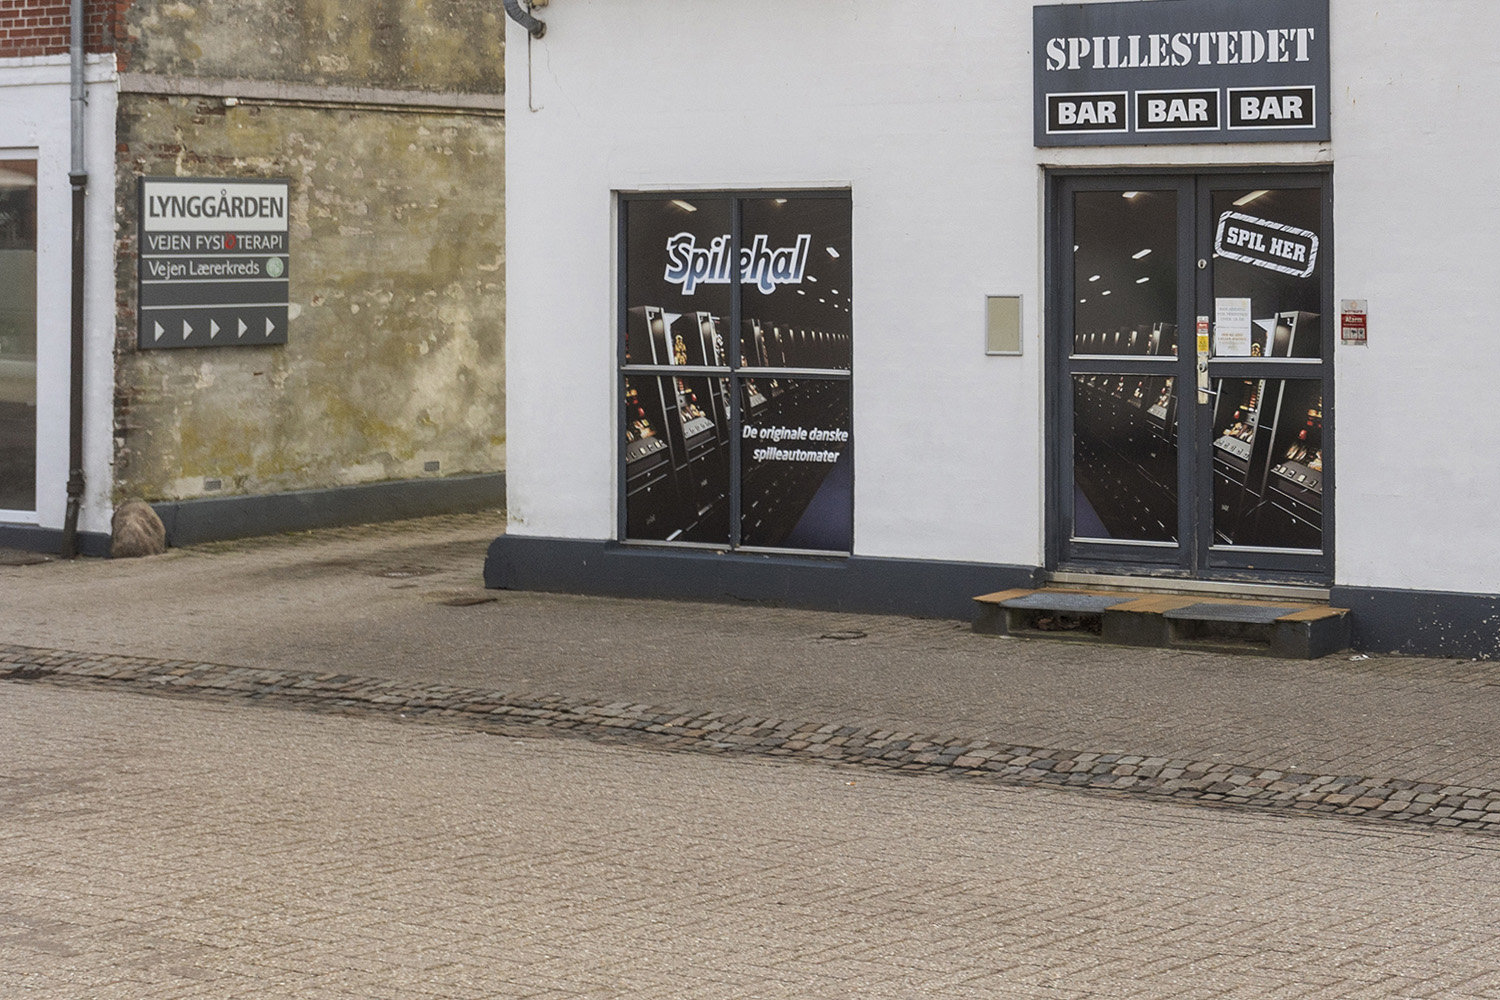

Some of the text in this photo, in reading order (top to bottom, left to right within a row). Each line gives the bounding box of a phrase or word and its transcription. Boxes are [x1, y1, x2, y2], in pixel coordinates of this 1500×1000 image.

[1046, 28, 1315, 71] SPILLESTEDET
[1058, 96, 1303, 125] BAR BAR BAR
[149, 189, 284, 218] LYNGGÅRDEN
[148, 233, 283, 251] VEJEN FYSIOTERAPI
[1226, 226, 1306, 263] SPIL HER
[148, 261, 187, 280] Vejen
[189, 260, 260, 277] Lærerkreds
[664, 232, 811, 295] Spilehal
[742, 425, 849, 442] De originale danske
[752, 446, 840, 463] spilleautomater
